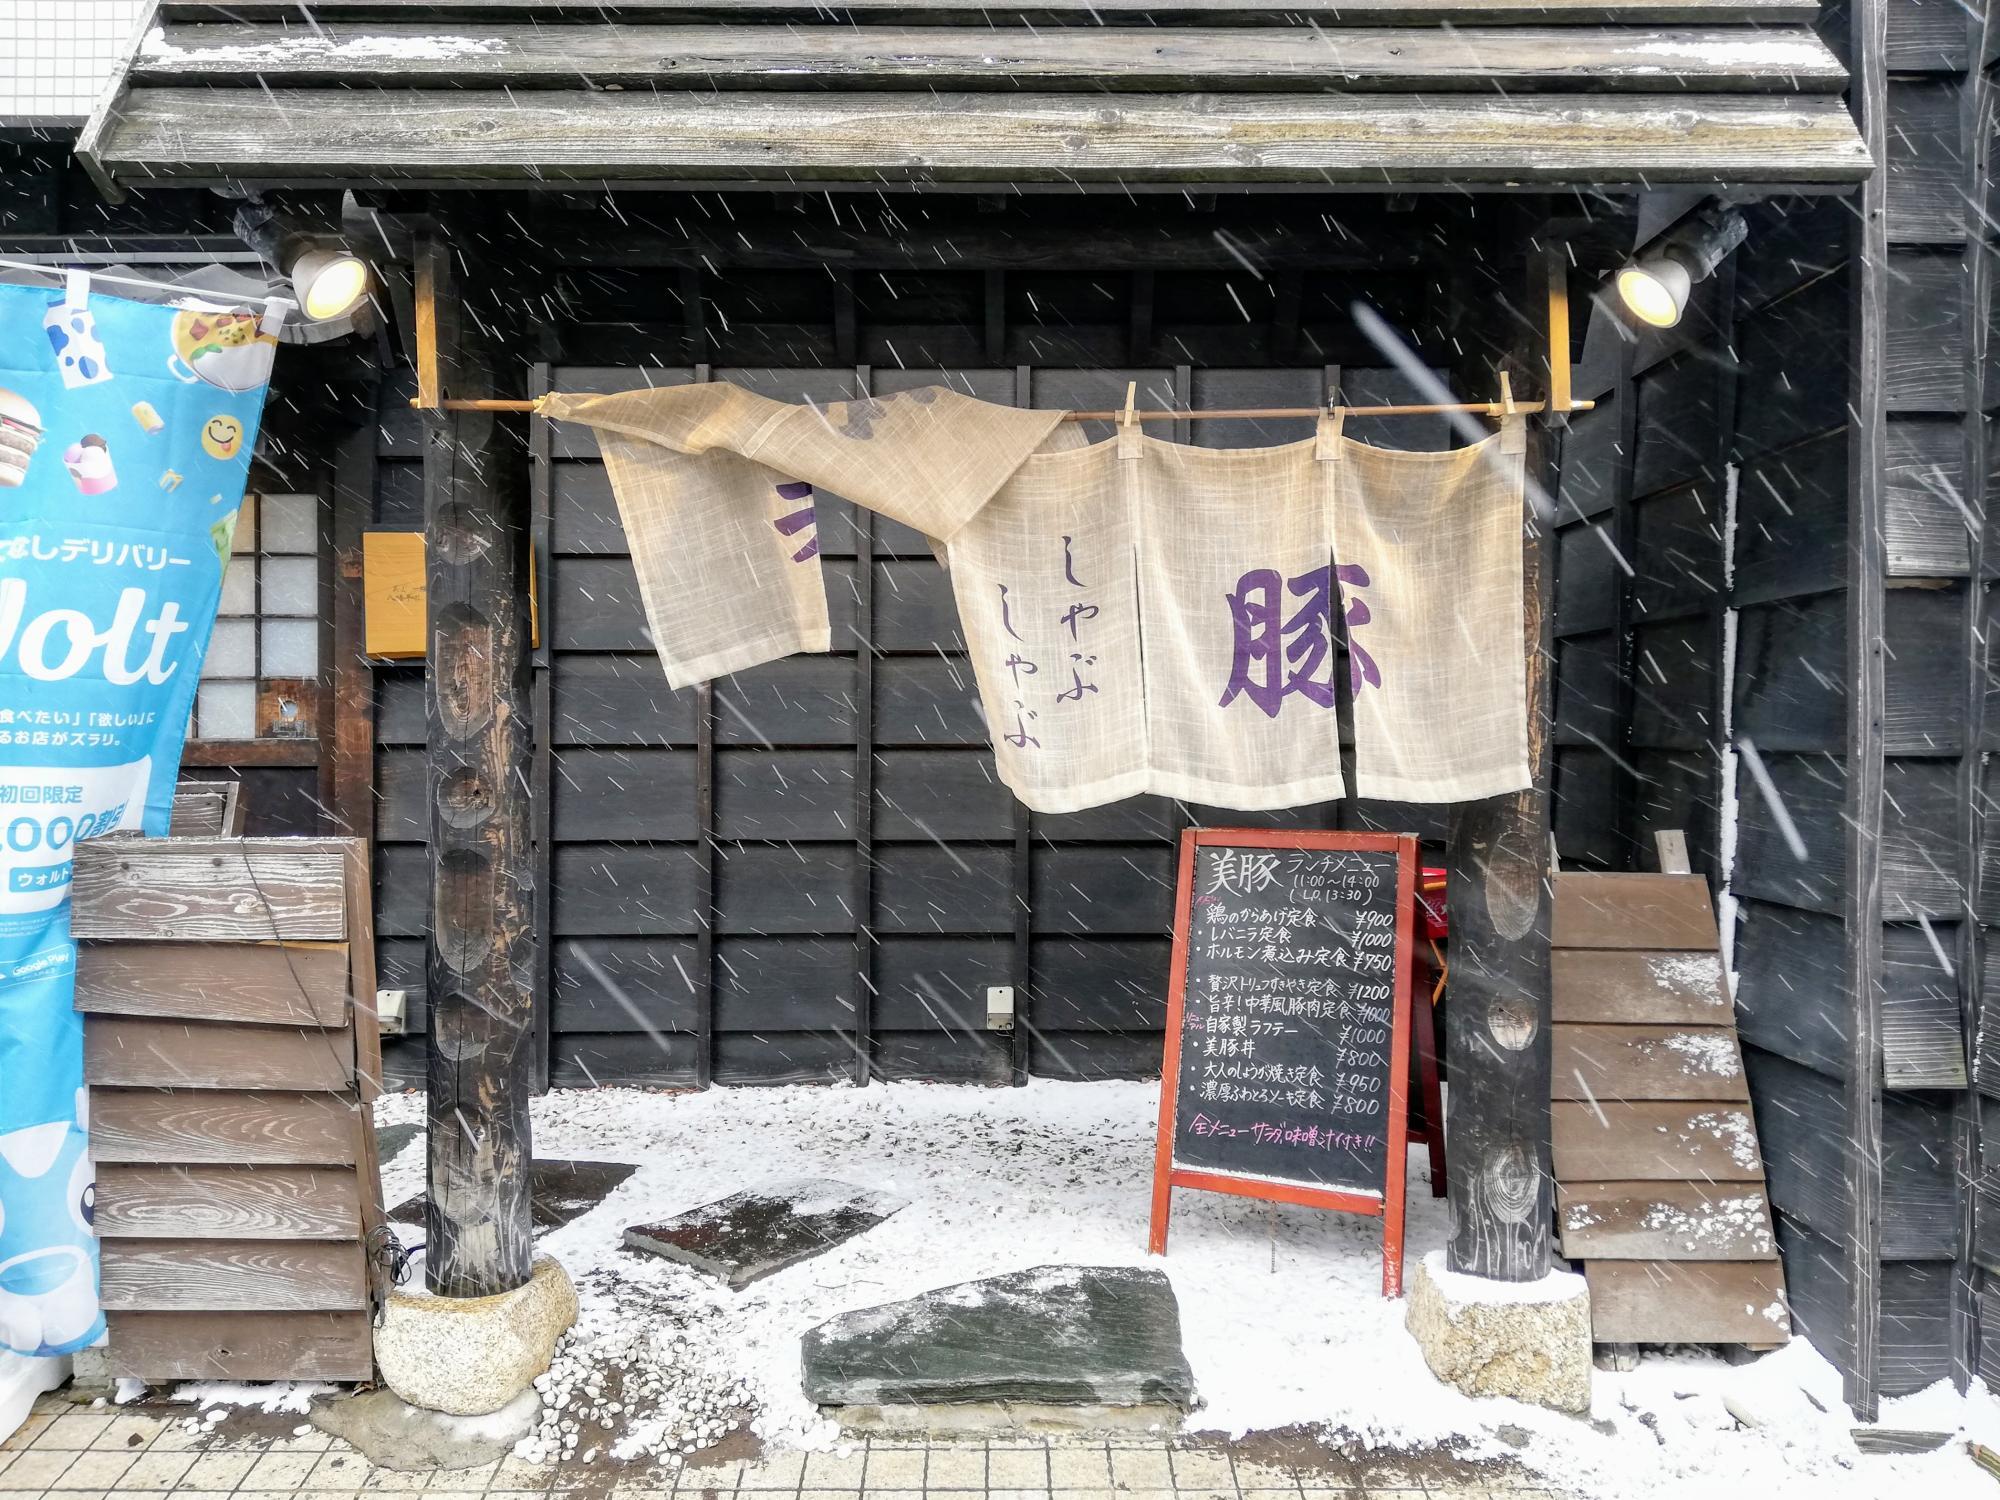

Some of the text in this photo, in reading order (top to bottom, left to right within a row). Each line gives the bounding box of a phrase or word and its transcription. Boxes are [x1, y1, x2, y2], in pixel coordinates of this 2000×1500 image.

[0, 577, 188, 686] olt
[1218, 564, 1381, 719] 豚
[0, 785, 84, 804] 初回限定
[1205, 848, 1391, 898] 美豚 ランチメニュー
[1206, 902, 1394, 930] 鶏のからあげ定食 ¥900
[1211, 926, 1392, 950] レバニラ定食 ¥1000
[1206, 943, 1392, 972] ホルモン煮込み定食 ¥750
[1348, 983, 1391, 1001] ¥1200
[1340, 1025, 1386, 1046] ¥1000
[1335, 1047, 1380, 1069] ¥800
[1203, 1060, 1381, 1093] 大人のしょうが焼き定食 ¥950
[1330, 1094, 1380, 1115] ¥800
